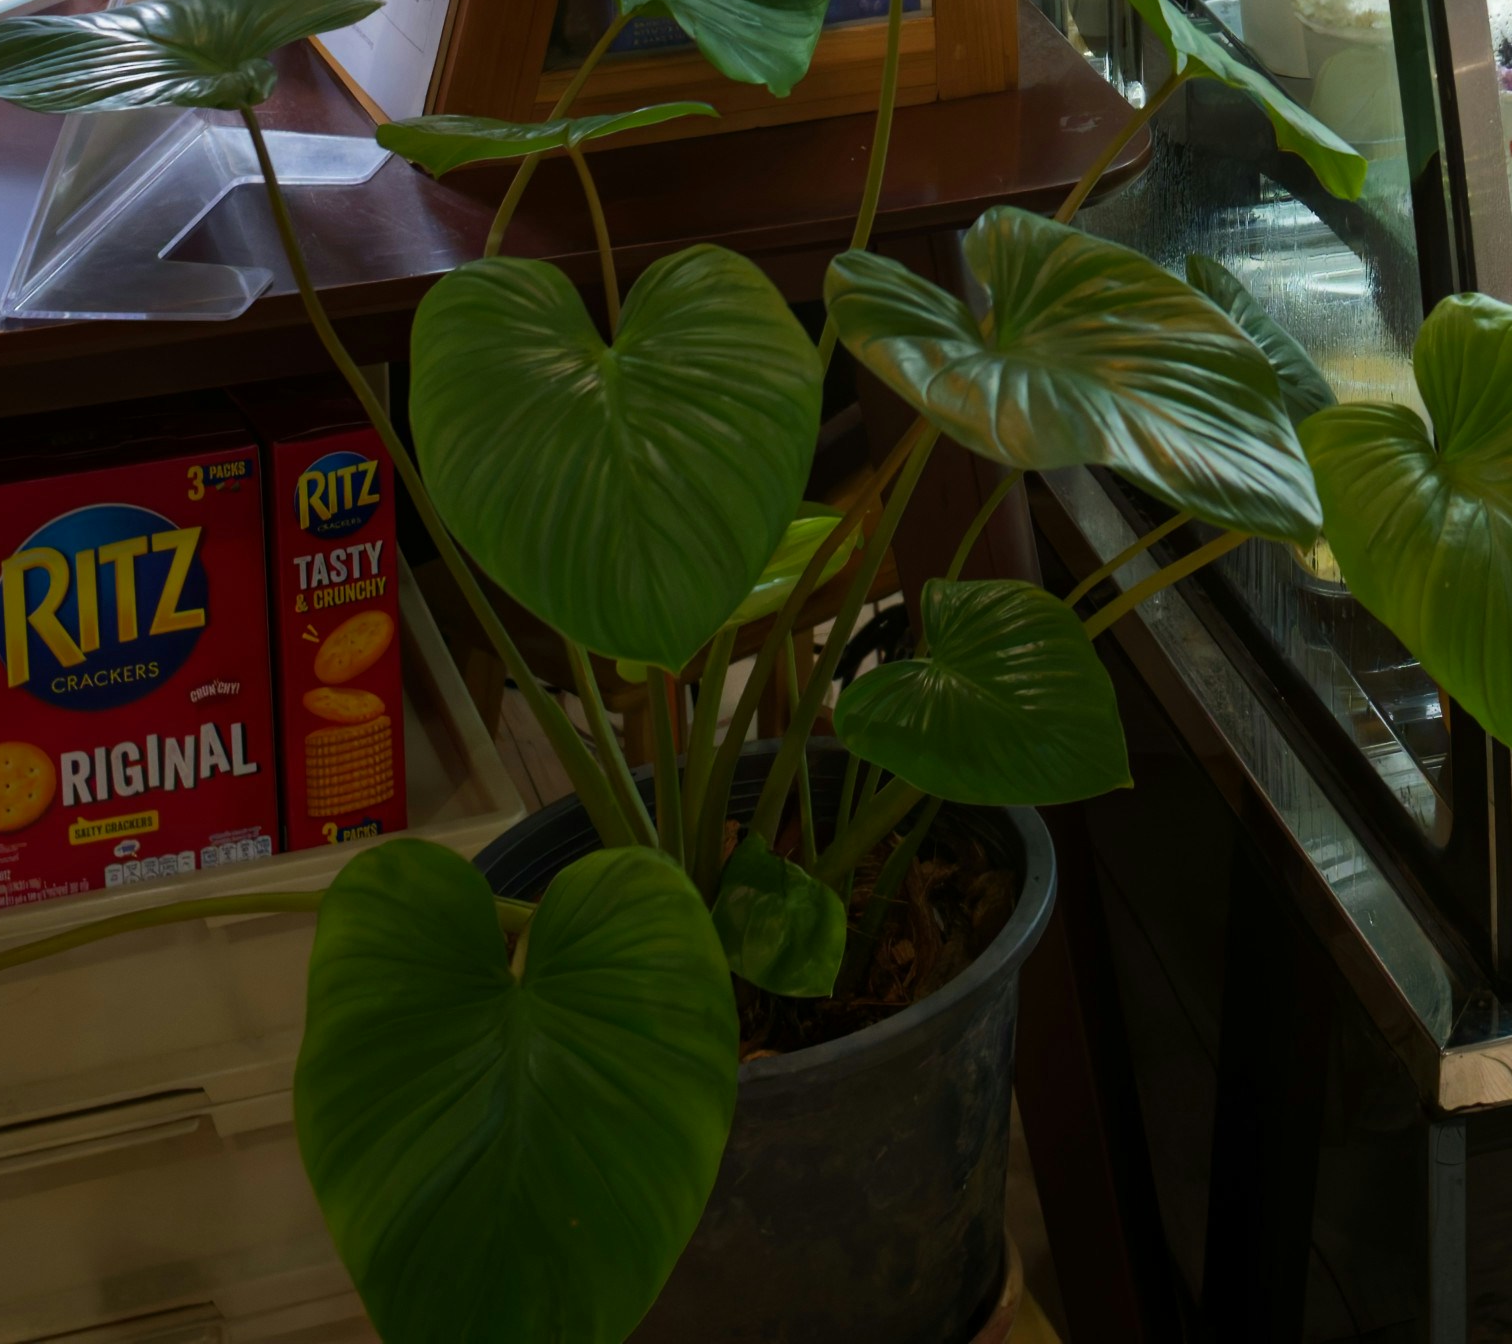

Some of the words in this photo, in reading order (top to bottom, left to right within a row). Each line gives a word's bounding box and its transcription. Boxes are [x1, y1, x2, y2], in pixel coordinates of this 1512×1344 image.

[188, 465, 205, 501] 3
[209, 461, 246, 480] PACKS
[297, 459, 381, 531] RITZ
[316, 516, 363, 533] CRACKERS
[293, 539, 383, 591] TASTY
[2, 526, 206, 689] RITZ
[295, 593, 309, 613] &
[313, 576, 387, 609] CRUNCHY
[52, 662, 160, 694] CRACKERS
[75, 824, 102, 840] SALTY
[105, 816, 154, 835] CRACKERS
[321, 821, 339, 845] 3
[342, 823, 378, 842] PACKS
